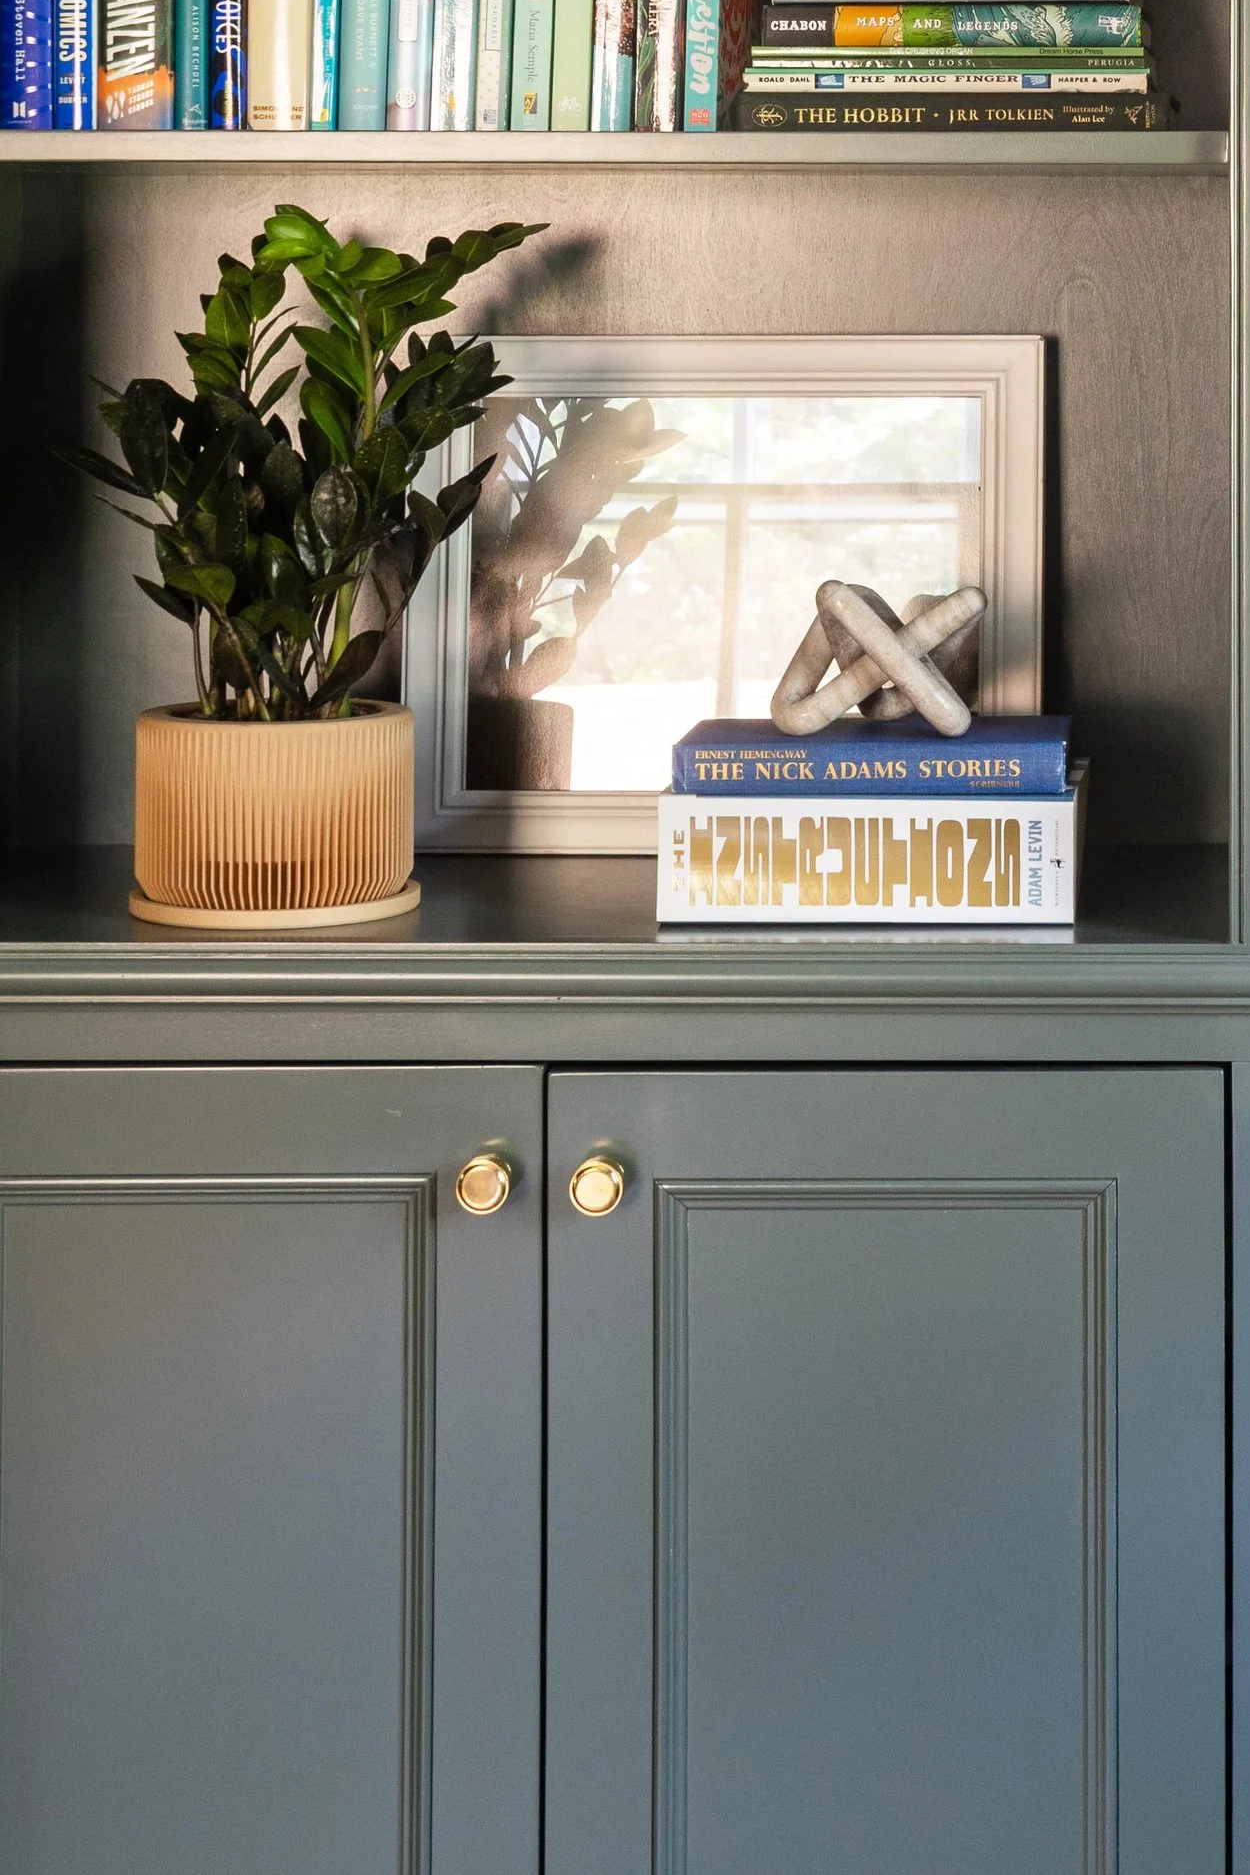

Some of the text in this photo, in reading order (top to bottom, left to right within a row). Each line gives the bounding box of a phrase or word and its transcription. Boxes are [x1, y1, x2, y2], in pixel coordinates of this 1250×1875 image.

[771, 18, 1018, 32] CHABON MAPS AND LEGENDS
[794, 108, 839, 123] THE
[844, 108, 925, 124] HOBBIT
[986, 108, 1053, 122] TOLKIEN
[695, 759, 1020, 781] THE NICK ADAMS STORIES
